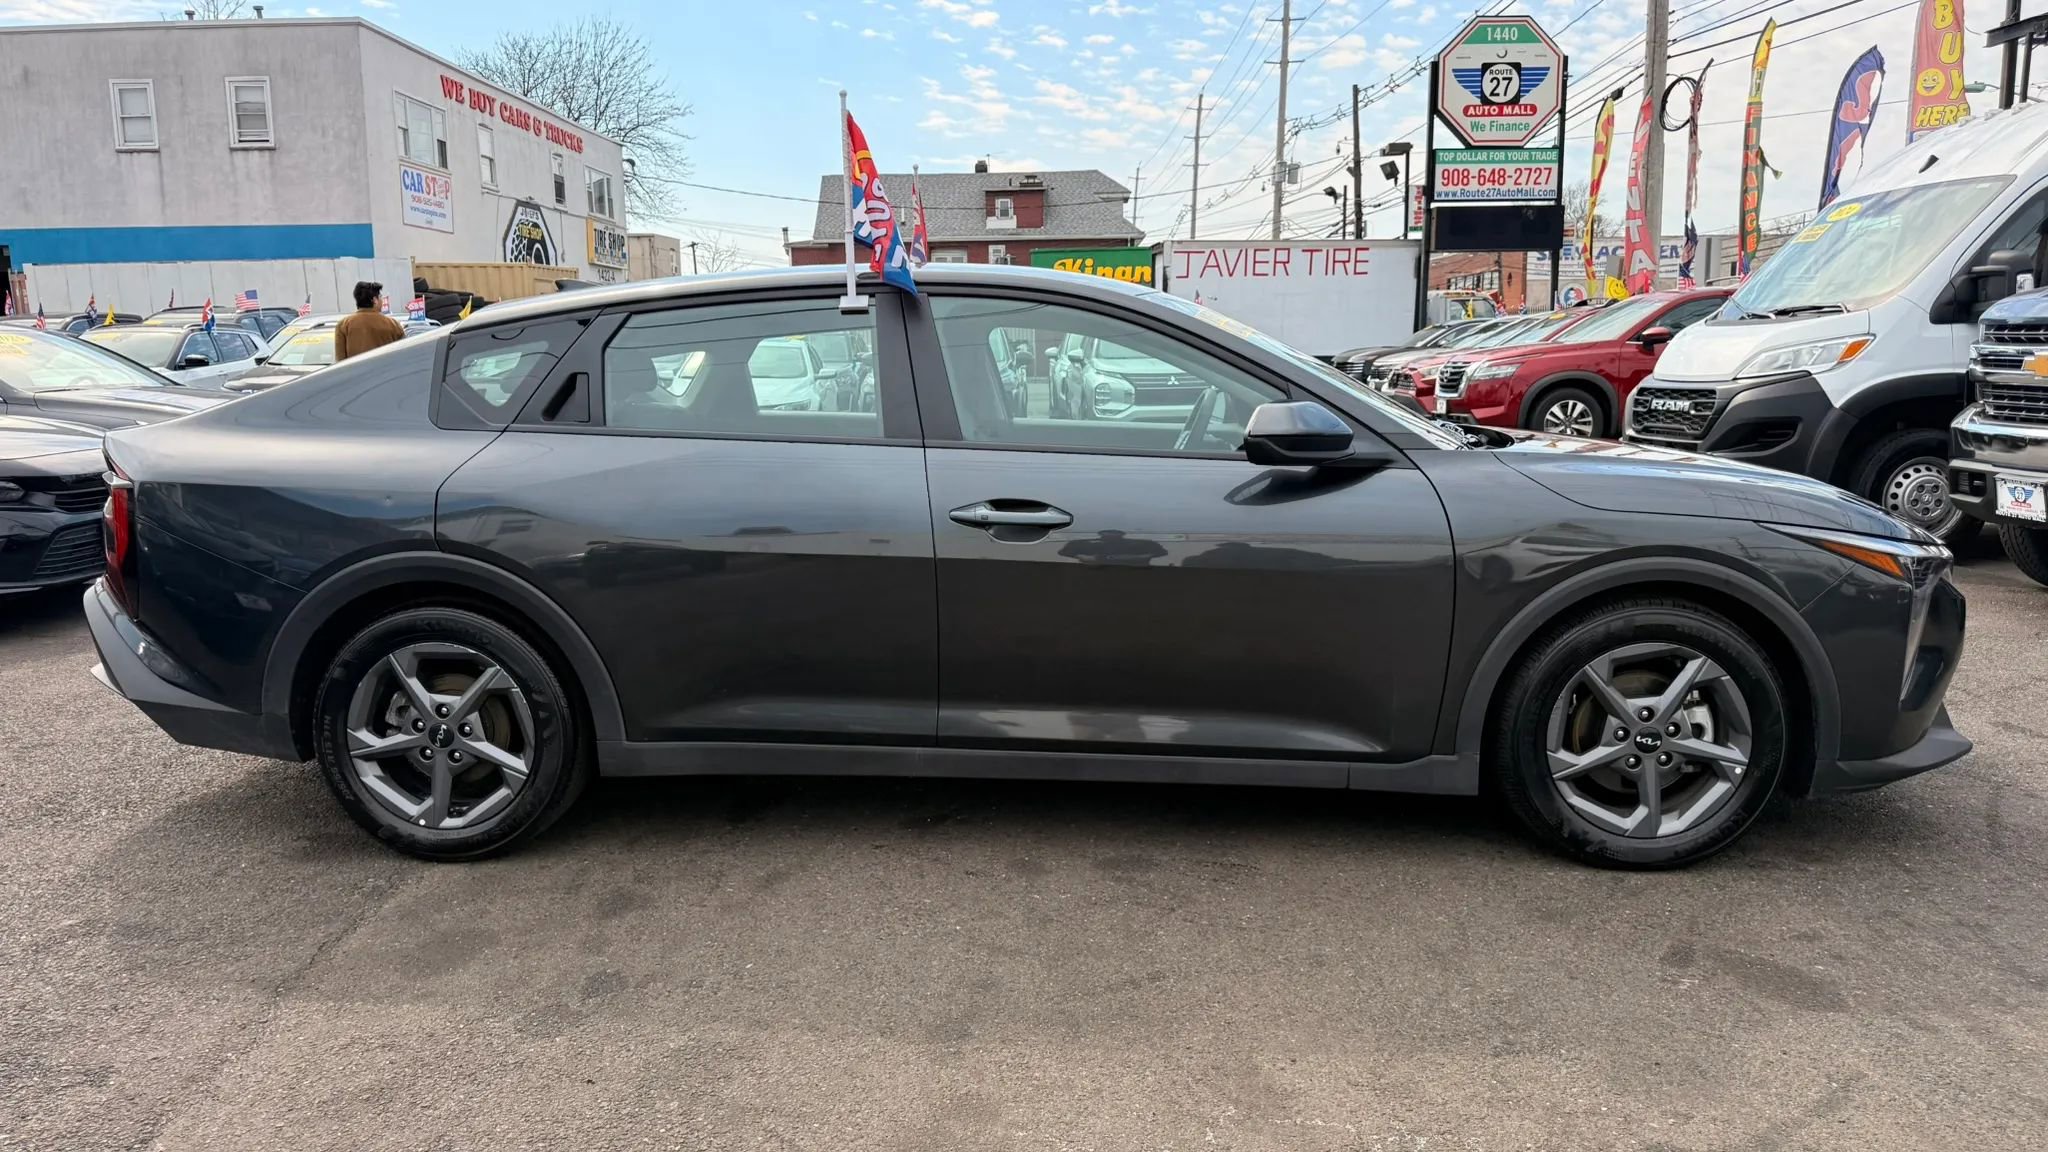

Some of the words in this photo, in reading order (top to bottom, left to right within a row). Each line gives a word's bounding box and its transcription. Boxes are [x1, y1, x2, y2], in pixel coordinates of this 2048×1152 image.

[1486, 27, 1518, 41] 1440
[1932, 0, 1964, 100] BUY
[1489, 68, 1513, 76] ROUTE
[1489, 77, 1513, 97] 27
[440, 75, 465, 104] WE
[468, 88, 496, 117] BUY
[499, 102, 531, 131] CARS
[533, 117, 541, 136] &
[544, 121, 583, 154] TRUCKS
[1467, 106, 1499, 116] AUTO
[1503, 105, 1534, 115] MALL
[1915, 103, 1969, 128] HERE
[1470, 120, 1486, 132] We
[1489, 120, 1530, 132] Finance
[1439, 152, 1452, 161] TOP
[1456, 152, 1488, 161] DOLLAR
[1489, 152, 1505, 161] FOR
[1507, 151, 1528, 160] YOUR
[1531, 151, 1557, 160] TRADE
[402, 169, 424, 194] CAR
[1441, 167, 1553, 187] 908-648-2727
[1743, 105, 1763, 253] FINANCE
[1436, 188, 1556, 198] www.Route27AutoMall.com
[593, 227, 607, 249] TIRE
[608, 232, 625, 250] SHOP
[1174, 247, 1291, 279] JAVIER
[1302, 247, 1370, 276] TIRE
[1650, 398, 1690, 412] RAM
